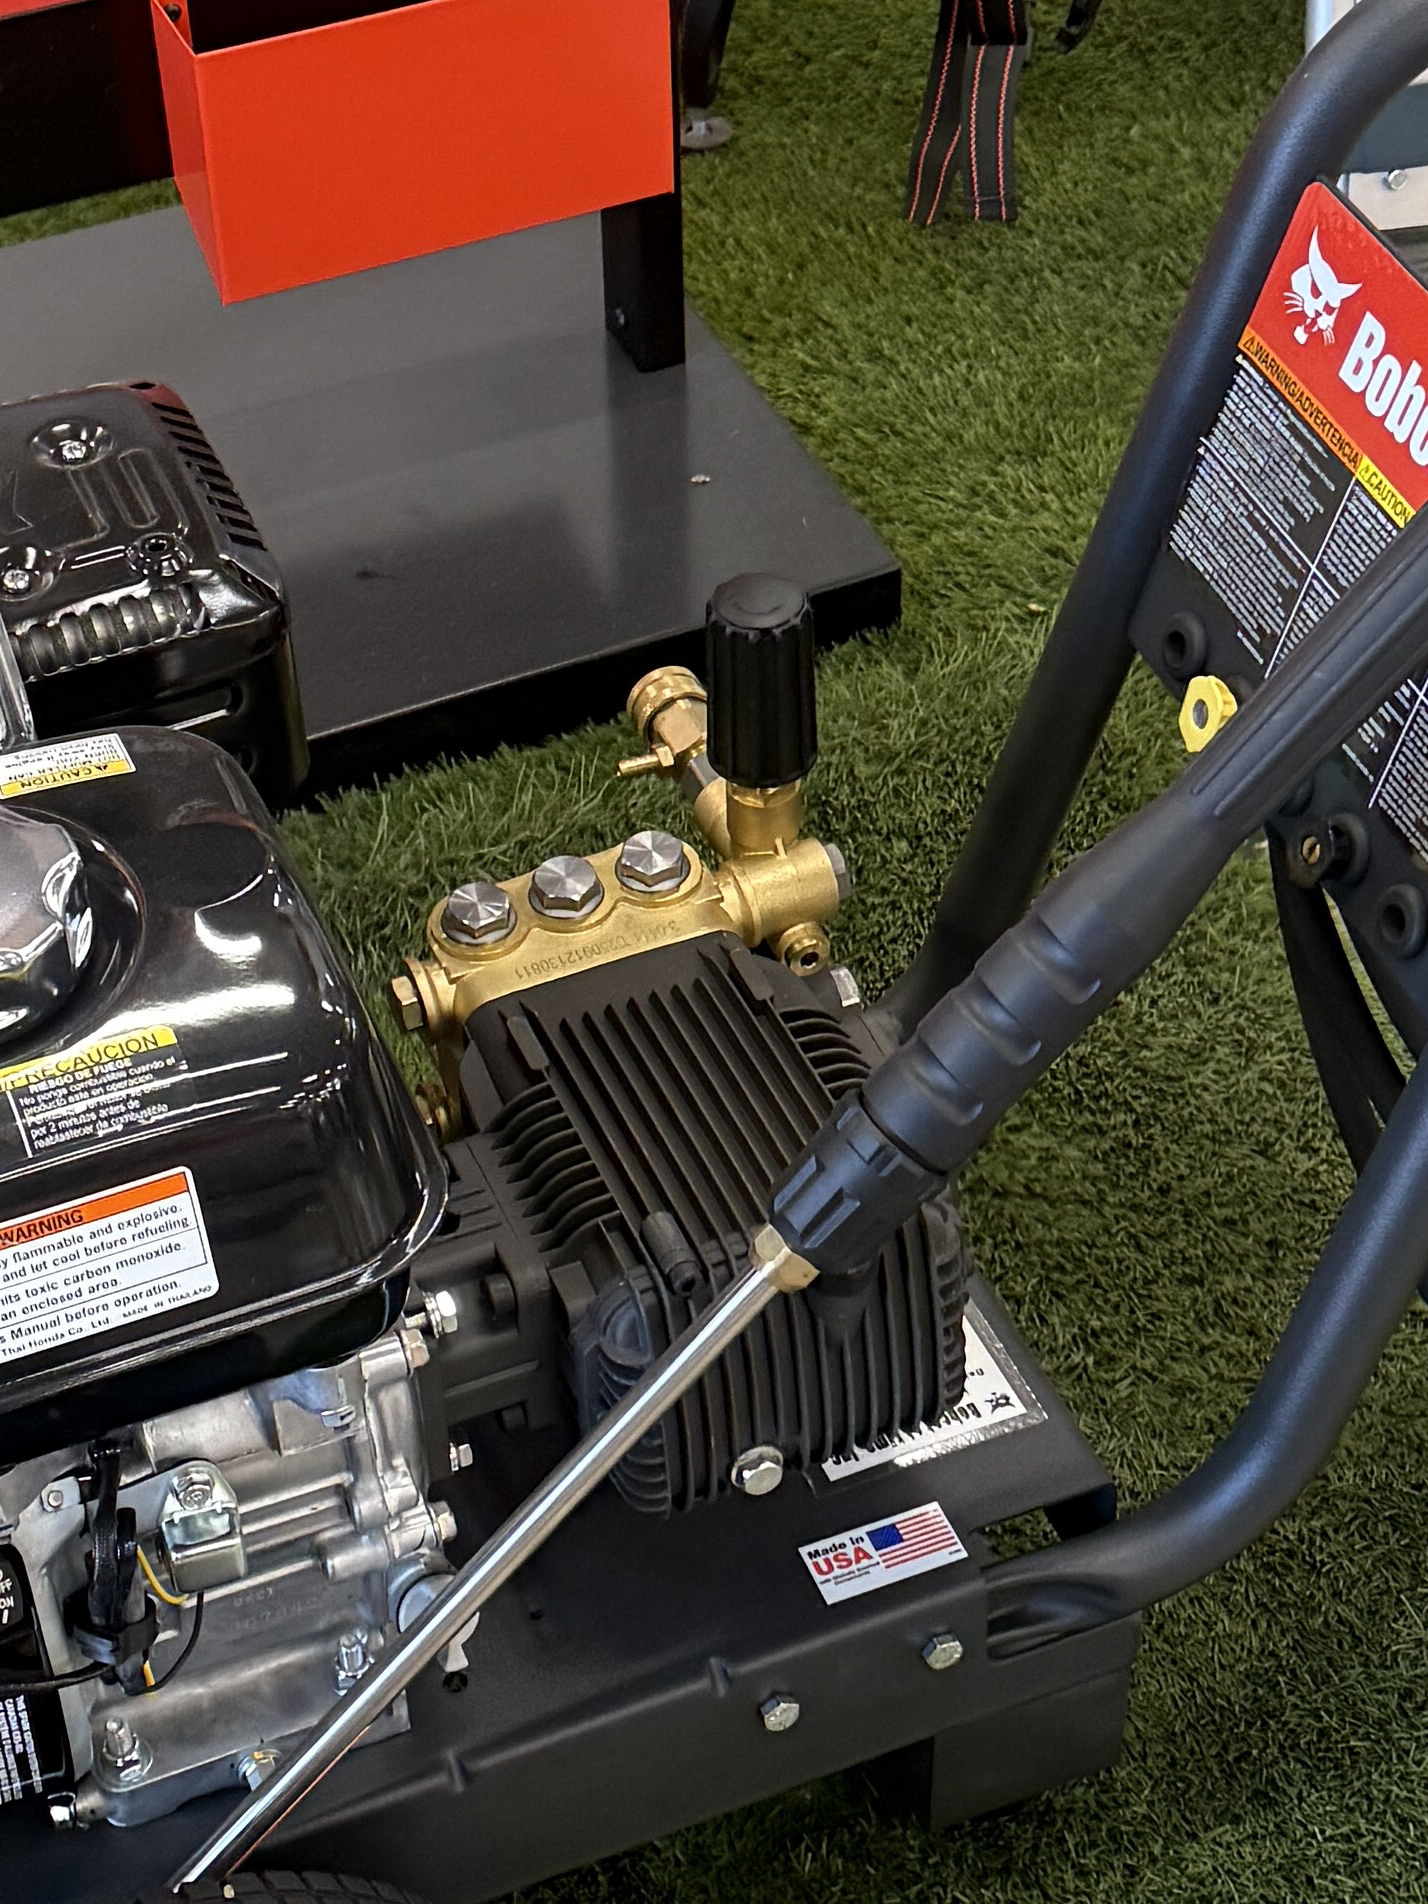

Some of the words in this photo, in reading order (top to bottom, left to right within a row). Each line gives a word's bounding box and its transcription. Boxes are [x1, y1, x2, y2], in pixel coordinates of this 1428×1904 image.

[1253, 343, 1359, 472] WARNING/ADVERTENCIA
[1365, 473, 1411, 523] CAUTION
[19, 767, 92, 788] CAUTION
[12, 1234, 83, 1262] flammable
[89, 1223, 112, 1239] and
[117, 1205, 181, 1230] explosive.
[2, 1266, 26, 1282] and
[30, 1260, 47, 1273] let
[52, 1249, 80, 1266] cool
[83, 1237, 127, 1256] before
[24, 1281, 58, 1298] toxic
[63, 1264, 111, 1286] carbon
[115, 1242, 180, 1269] monoxide.
[0, 1310, 16, 1321] an
[21, 1287, 82, 1314] enclosed
[10, 1315, 60, 1339] Manual
[64, 1303, 109, 1322] before
[114, 1281, 177, 1307] operation.
[1, 1344, 25, 1356] Thai
[807, 1542, 846, 1559] Made
[848, 1535, 864, 1545] in
[812, 1546, 872, 1575] USA
